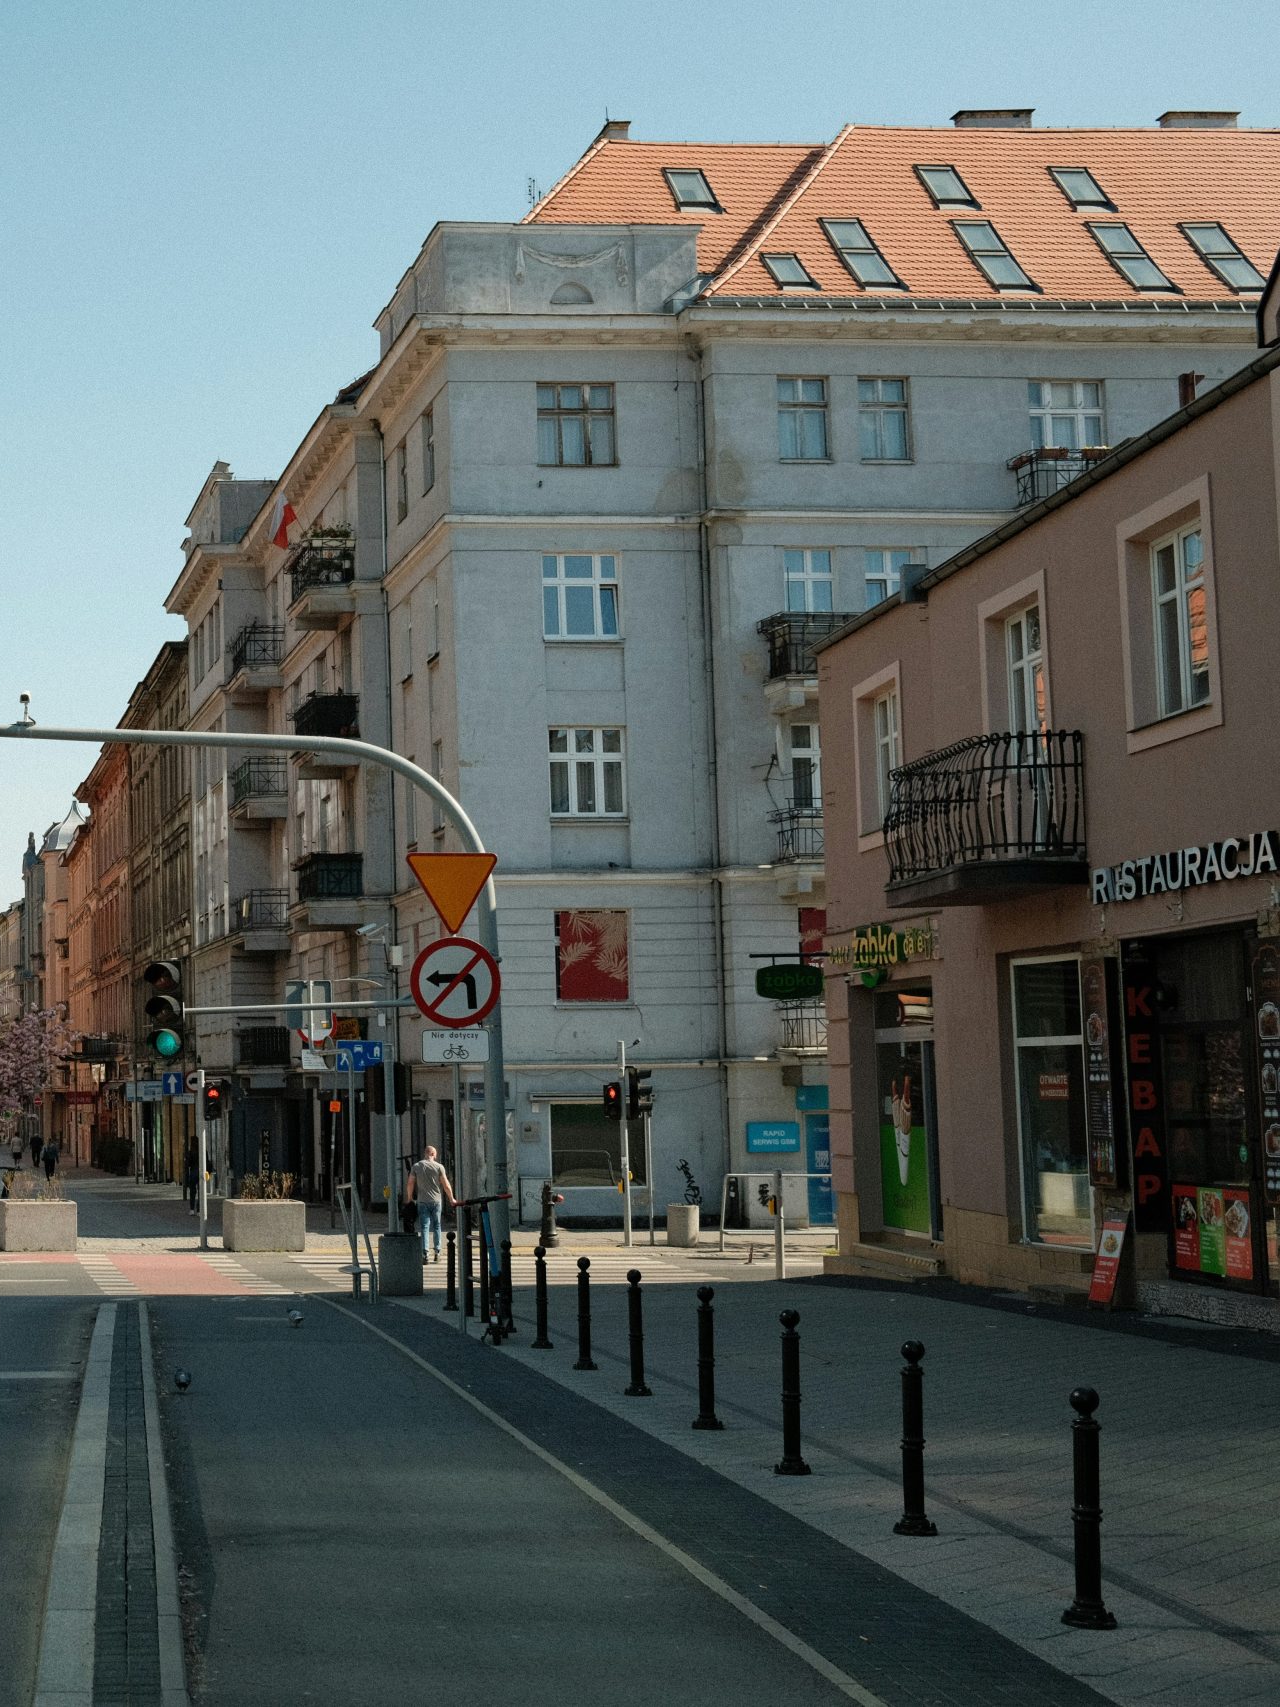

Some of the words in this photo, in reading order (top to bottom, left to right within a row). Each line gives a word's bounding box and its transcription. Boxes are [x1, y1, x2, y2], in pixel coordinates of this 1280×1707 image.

[431, 1031, 445, 1039] Nie
[449, 1031, 479, 1040] dotyczy
[1040, 1075, 1068, 1085] OTWARTE
[1127, 986, 1162, 1205] KEBAP
[763, 1129, 785, 1137] RAPID
